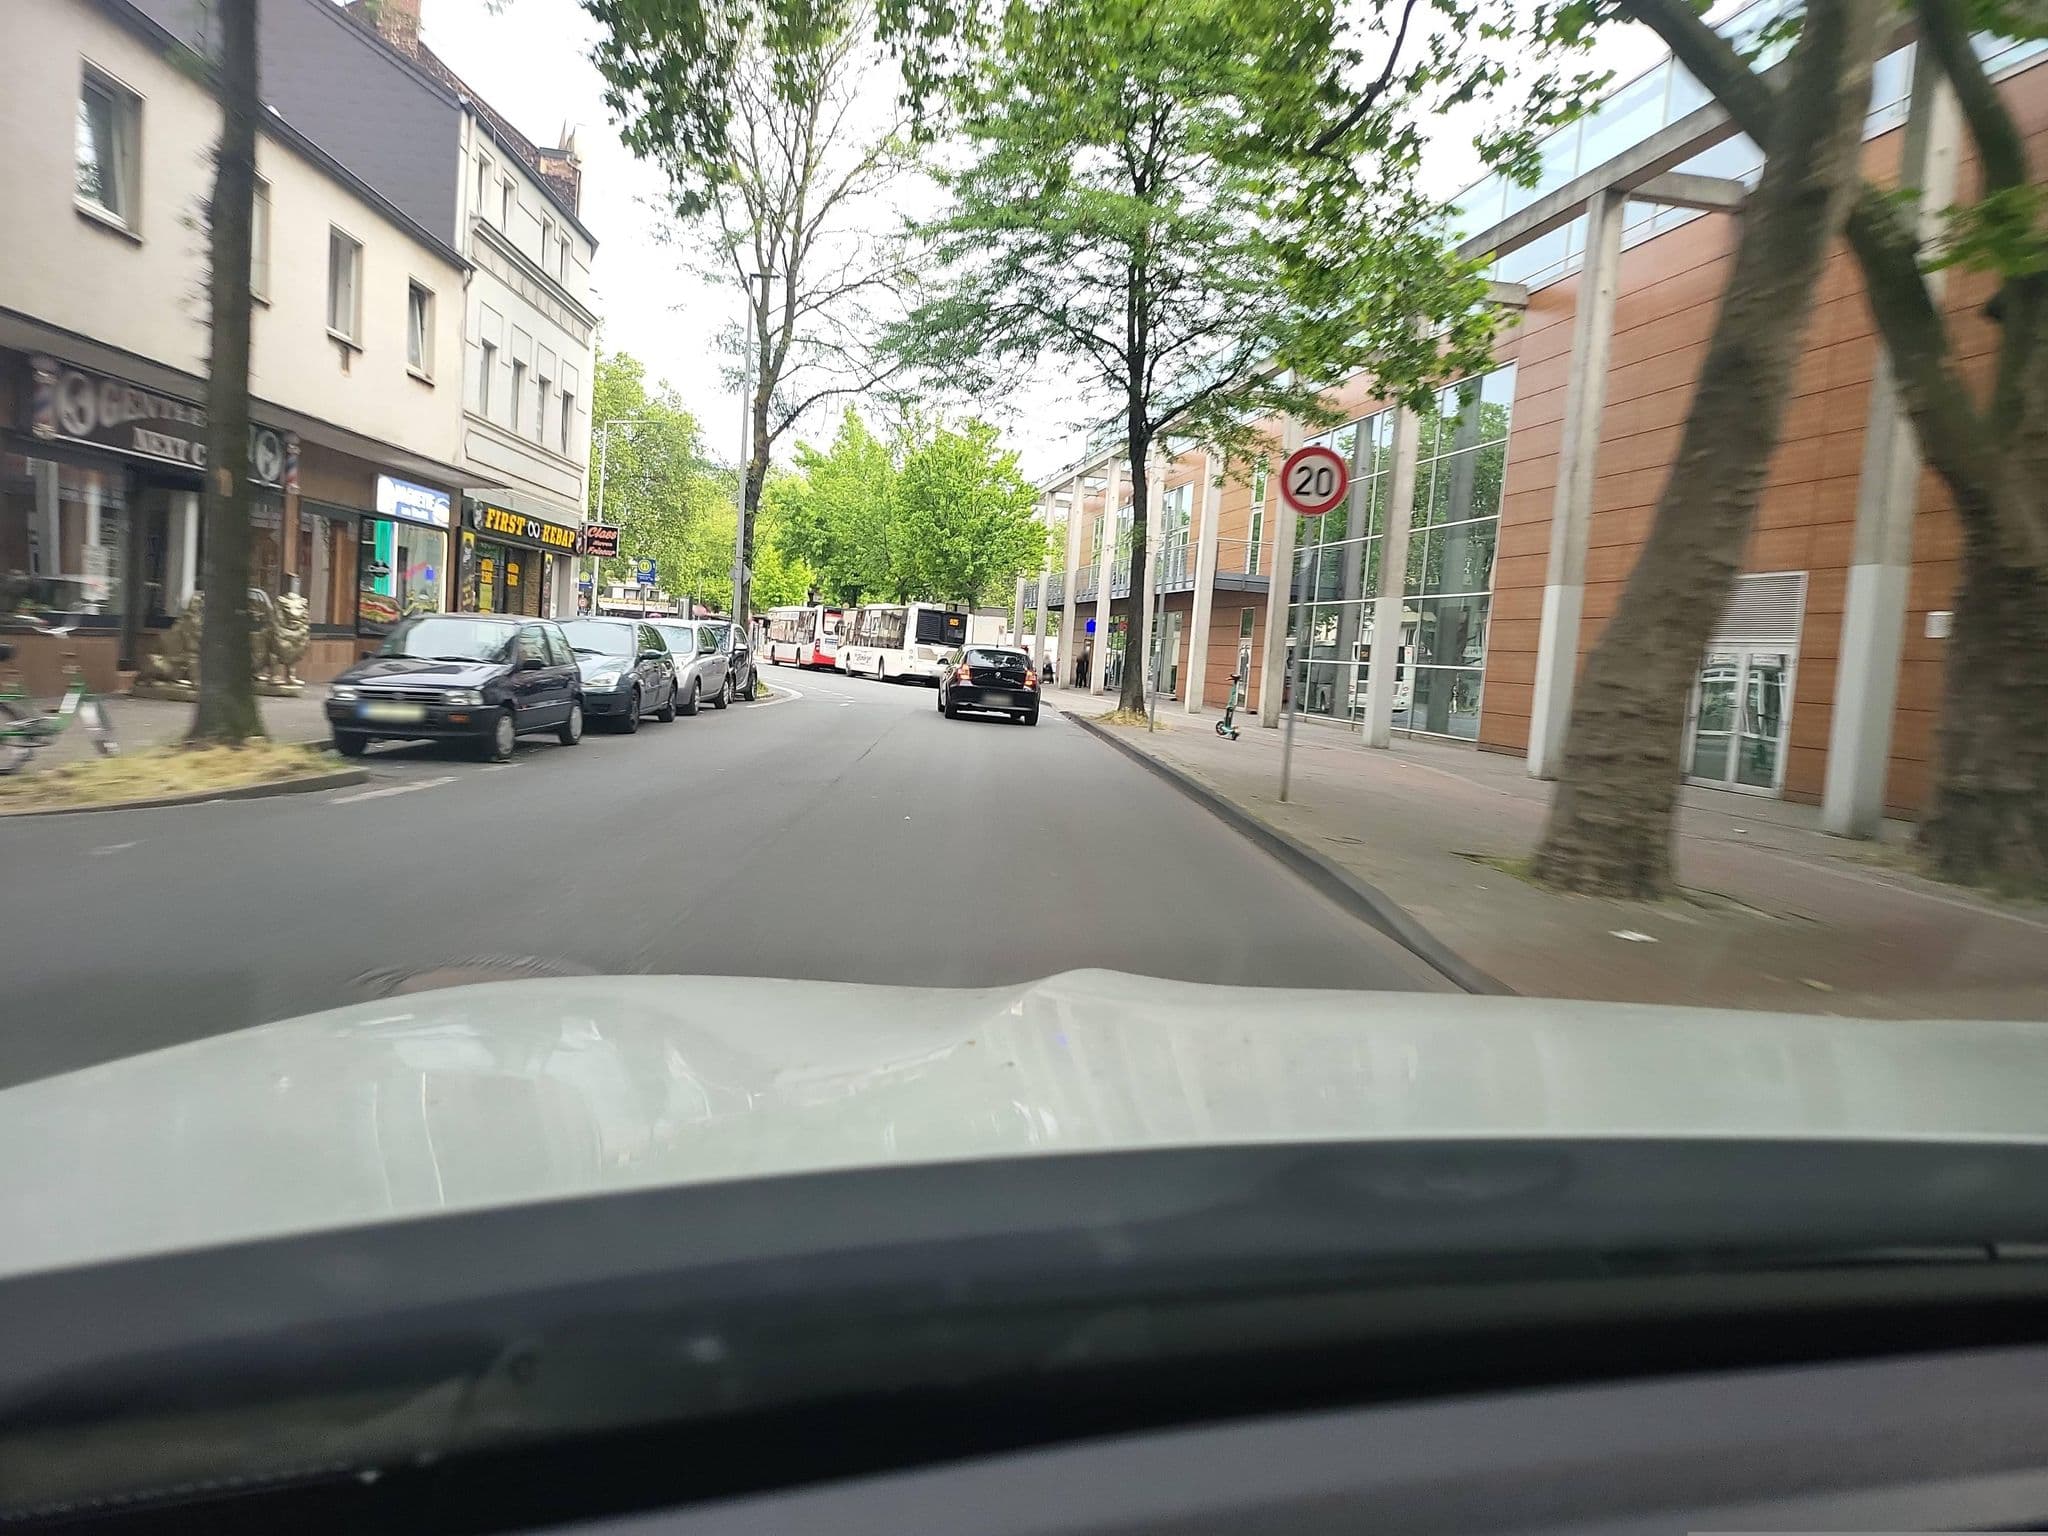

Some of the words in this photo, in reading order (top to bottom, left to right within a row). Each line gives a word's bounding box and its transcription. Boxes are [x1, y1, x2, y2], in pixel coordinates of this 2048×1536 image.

[1293, 466, 1334, 497] 20
[485, 507, 527, 537] FIRST
[541, 523, 576, 549] KEBAP
[587, 526, 618, 540] Class
